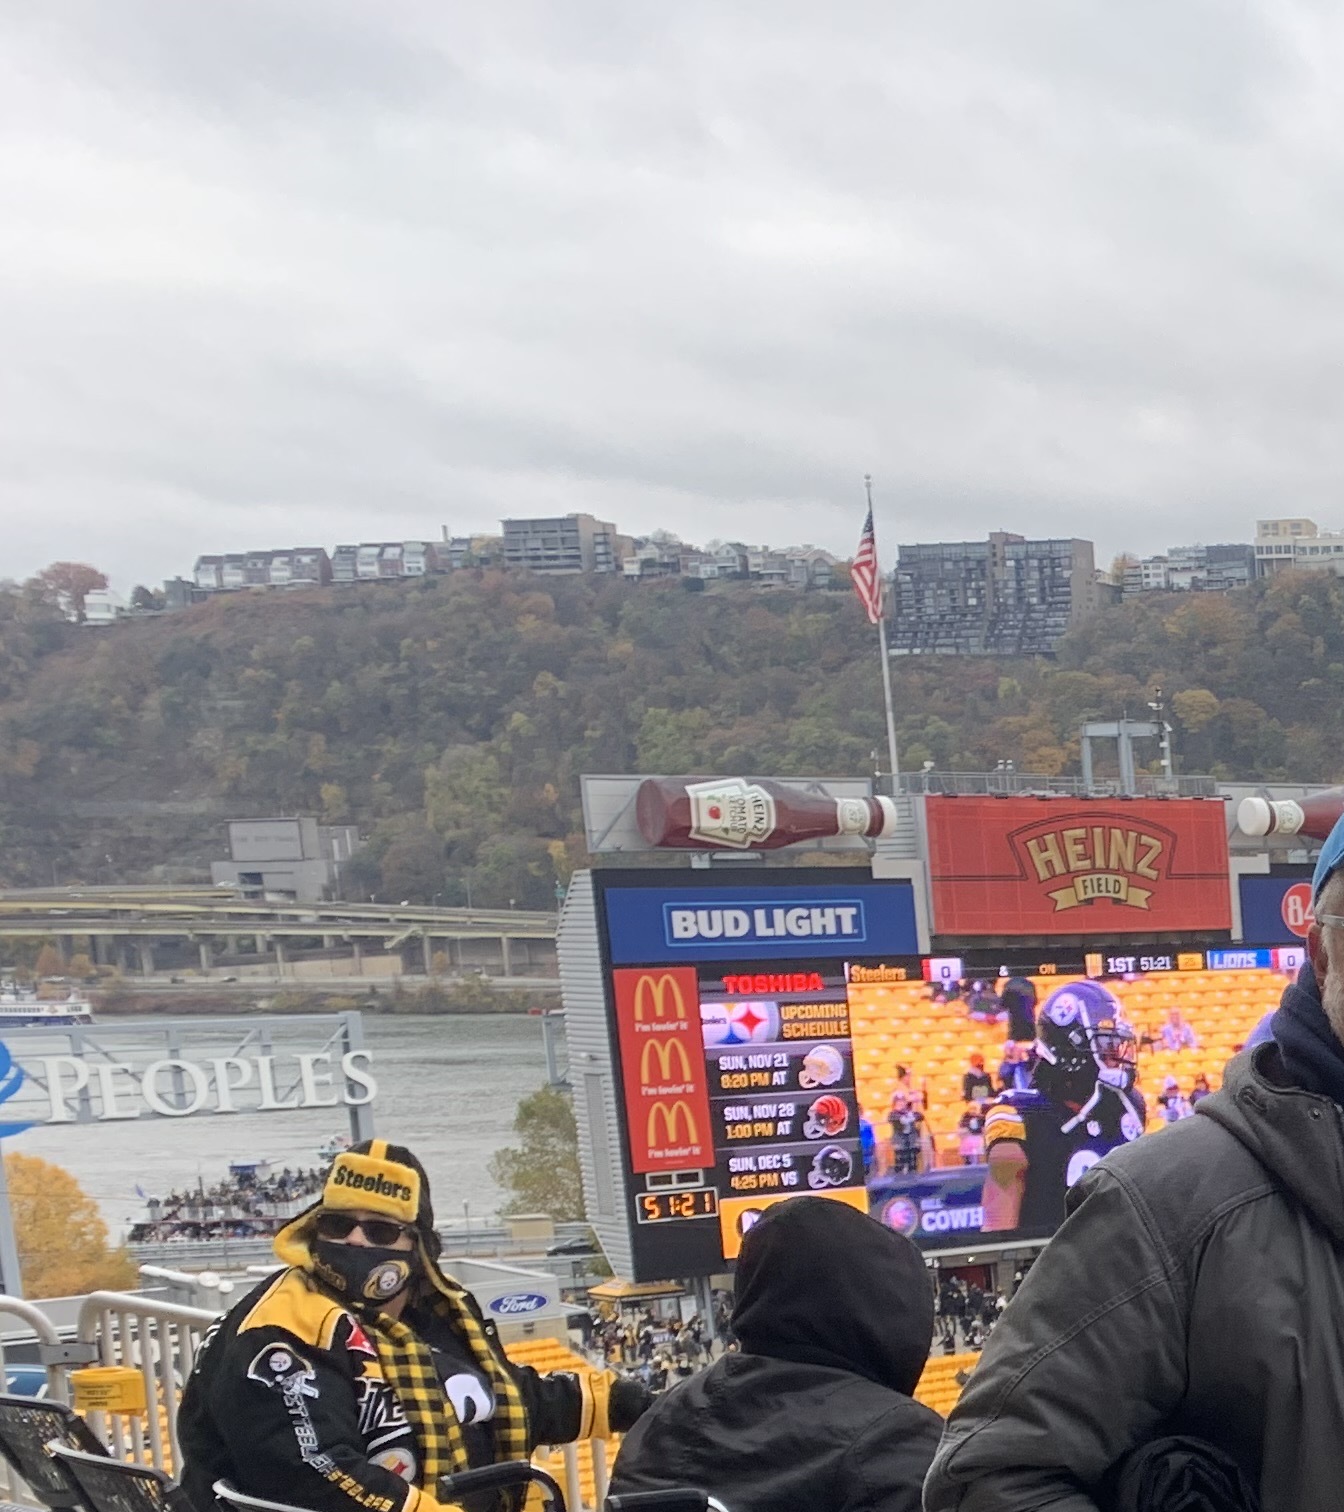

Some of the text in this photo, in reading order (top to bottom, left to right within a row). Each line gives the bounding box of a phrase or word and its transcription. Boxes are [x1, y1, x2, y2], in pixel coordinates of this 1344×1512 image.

[751, 793, 766, 832] HEINZ
[1025, 826, 1164, 883] HEINZ
[1082, 878, 1121, 896] FIELD
[671, 907, 858, 939] BUD LIGHT
[1107, 957, 1136, 973] 1ST
[1140, 956, 1171, 971] 51:21
[1213, 953, 1258, 969] LIONS
[850, 963, 907, 982] Steelers
[940, 966, 951, 978] 0
[723, 973, 824, 994] TOSHIBA
[781, 1003, 848, 1021] UPCOMING
[782, 1020, 848, 1039] SCHEDULE
[719, 1053, 789, 1072] SUN, NOV 21
[35, 1050, 378, 1123] PEOPLES
[750, 1072, 770, 1087] PM
[771, 1071, 787, 1085] AT
[723, 1102, 795, 1122] SUN, NOV 28
[725, 1121, 792, 1140] 1:00 PM AT
[728, 1153, 792, 1173] SUN, DEC 5
[333, 1164, 413, 1202] Steelers
[730, 1171, 798, 1190] 4:25 PM VS
[499, 1295, 539, 1314] Ford
